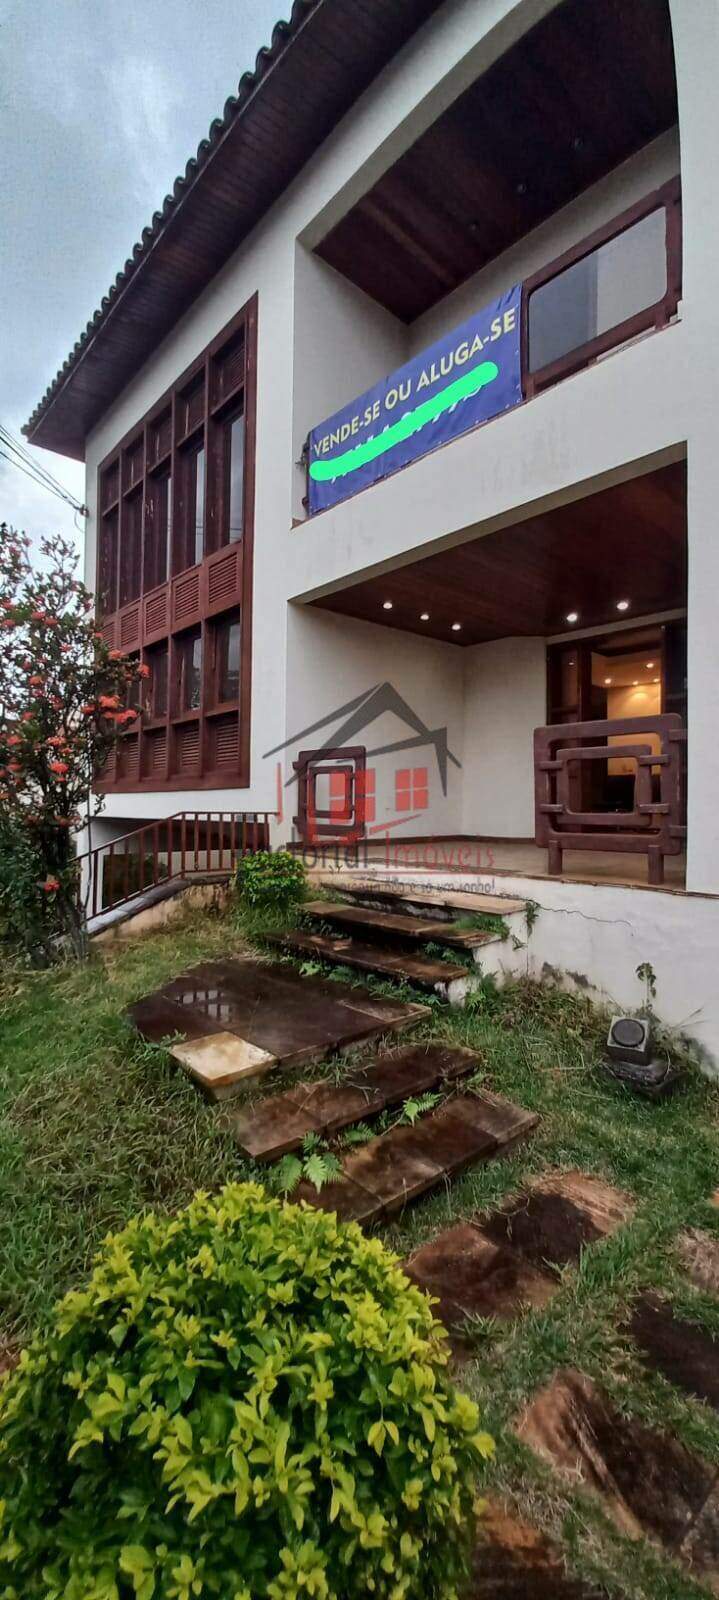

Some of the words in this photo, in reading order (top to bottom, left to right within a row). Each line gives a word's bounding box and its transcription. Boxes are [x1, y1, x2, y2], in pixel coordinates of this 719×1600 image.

[314, 400, 380, 457] VENDE-SE
[384, 379, 411, 410] OU
[416, 308, 515, 392] ALUGA-SE
